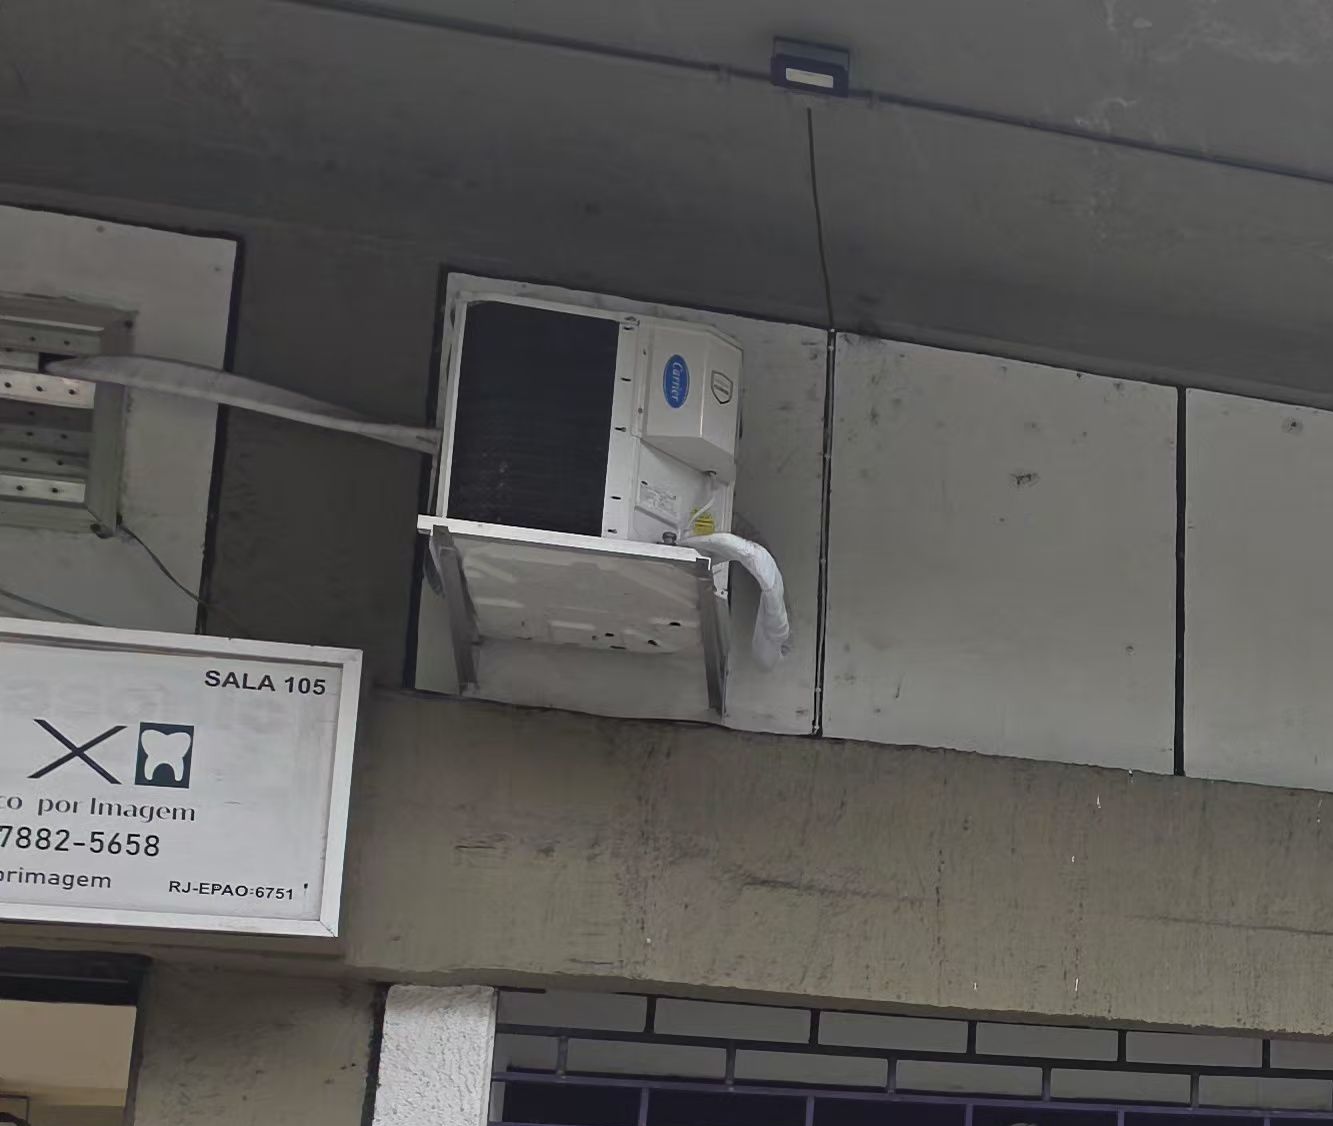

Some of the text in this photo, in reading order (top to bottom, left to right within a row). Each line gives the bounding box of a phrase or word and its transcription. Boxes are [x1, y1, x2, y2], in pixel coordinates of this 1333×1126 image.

[671, 361, 685, 403] Carrier
[204, 669, 327, 696] SALA 105
[38, 798, 82, 816] por
[90, 797, 197, 823] Imagem
[0, 825, 161, 857] 7882-5658
